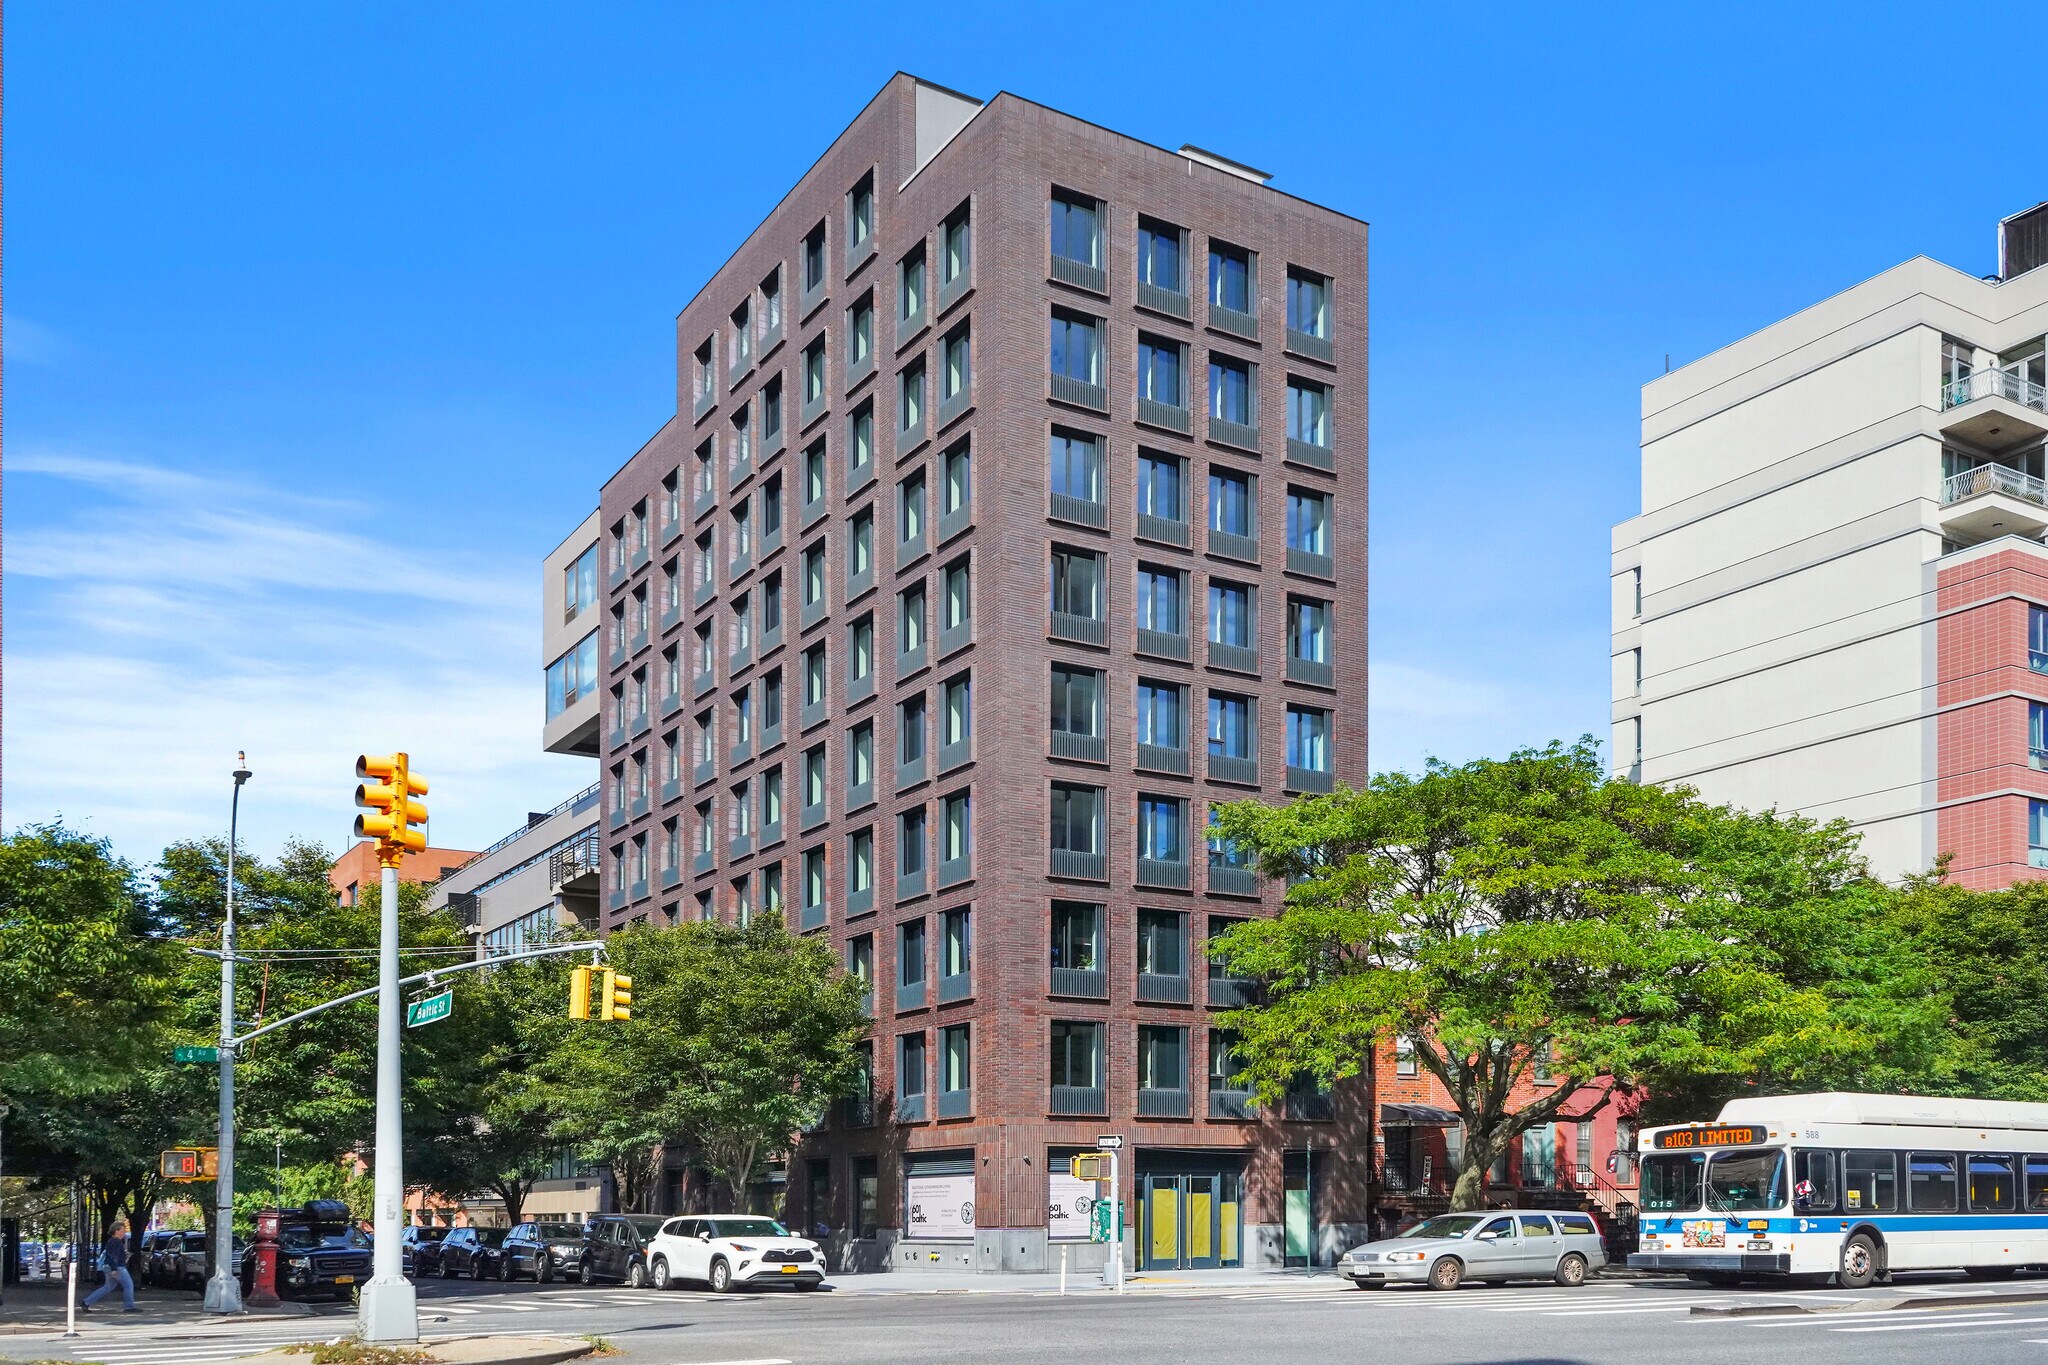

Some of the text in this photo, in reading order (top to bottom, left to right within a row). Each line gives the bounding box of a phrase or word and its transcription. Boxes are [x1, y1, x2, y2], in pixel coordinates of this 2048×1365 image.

[416, 1000, 446, 1020] Baltic St
[187, 1049, 193, 1060] 4
[1665, 1127, 1753, 1148] B103 LIMITED
[1805, 1130, 1820, 1139] 588
[1422, 1157, 1432, 1194] WELCOME
[911, 1204, 922, 1214] 601
[1049, 1204, 1061, 1213] 601
[1651, 1200, 1673, 1208] 015
[911, 1211, 927, 1223] baltic
[1049, 1211, 1069, 1220] baltic
